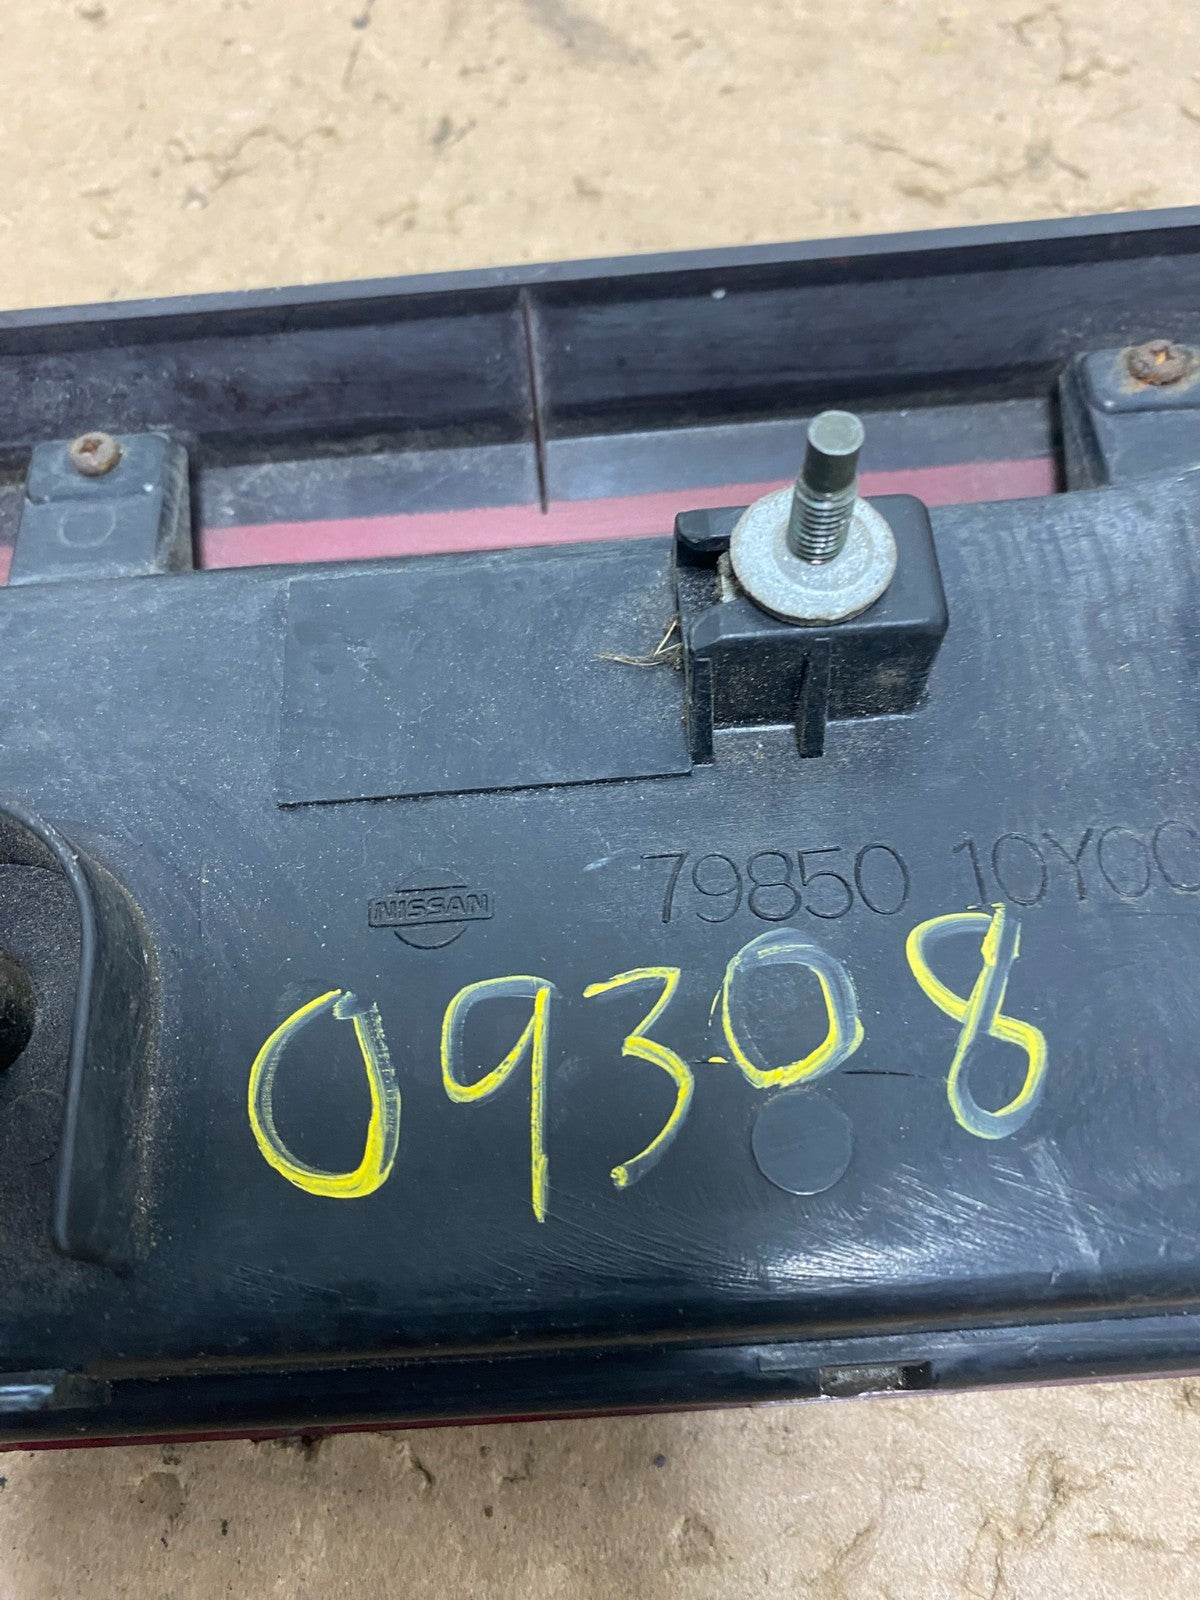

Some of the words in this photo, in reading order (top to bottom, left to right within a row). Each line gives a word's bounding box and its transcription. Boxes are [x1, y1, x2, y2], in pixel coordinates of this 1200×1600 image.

[373, 893, 489, 920] NISSAN
[641, 842, 910, 923] 79850
[248, 903, 1048, 1222] 09308
